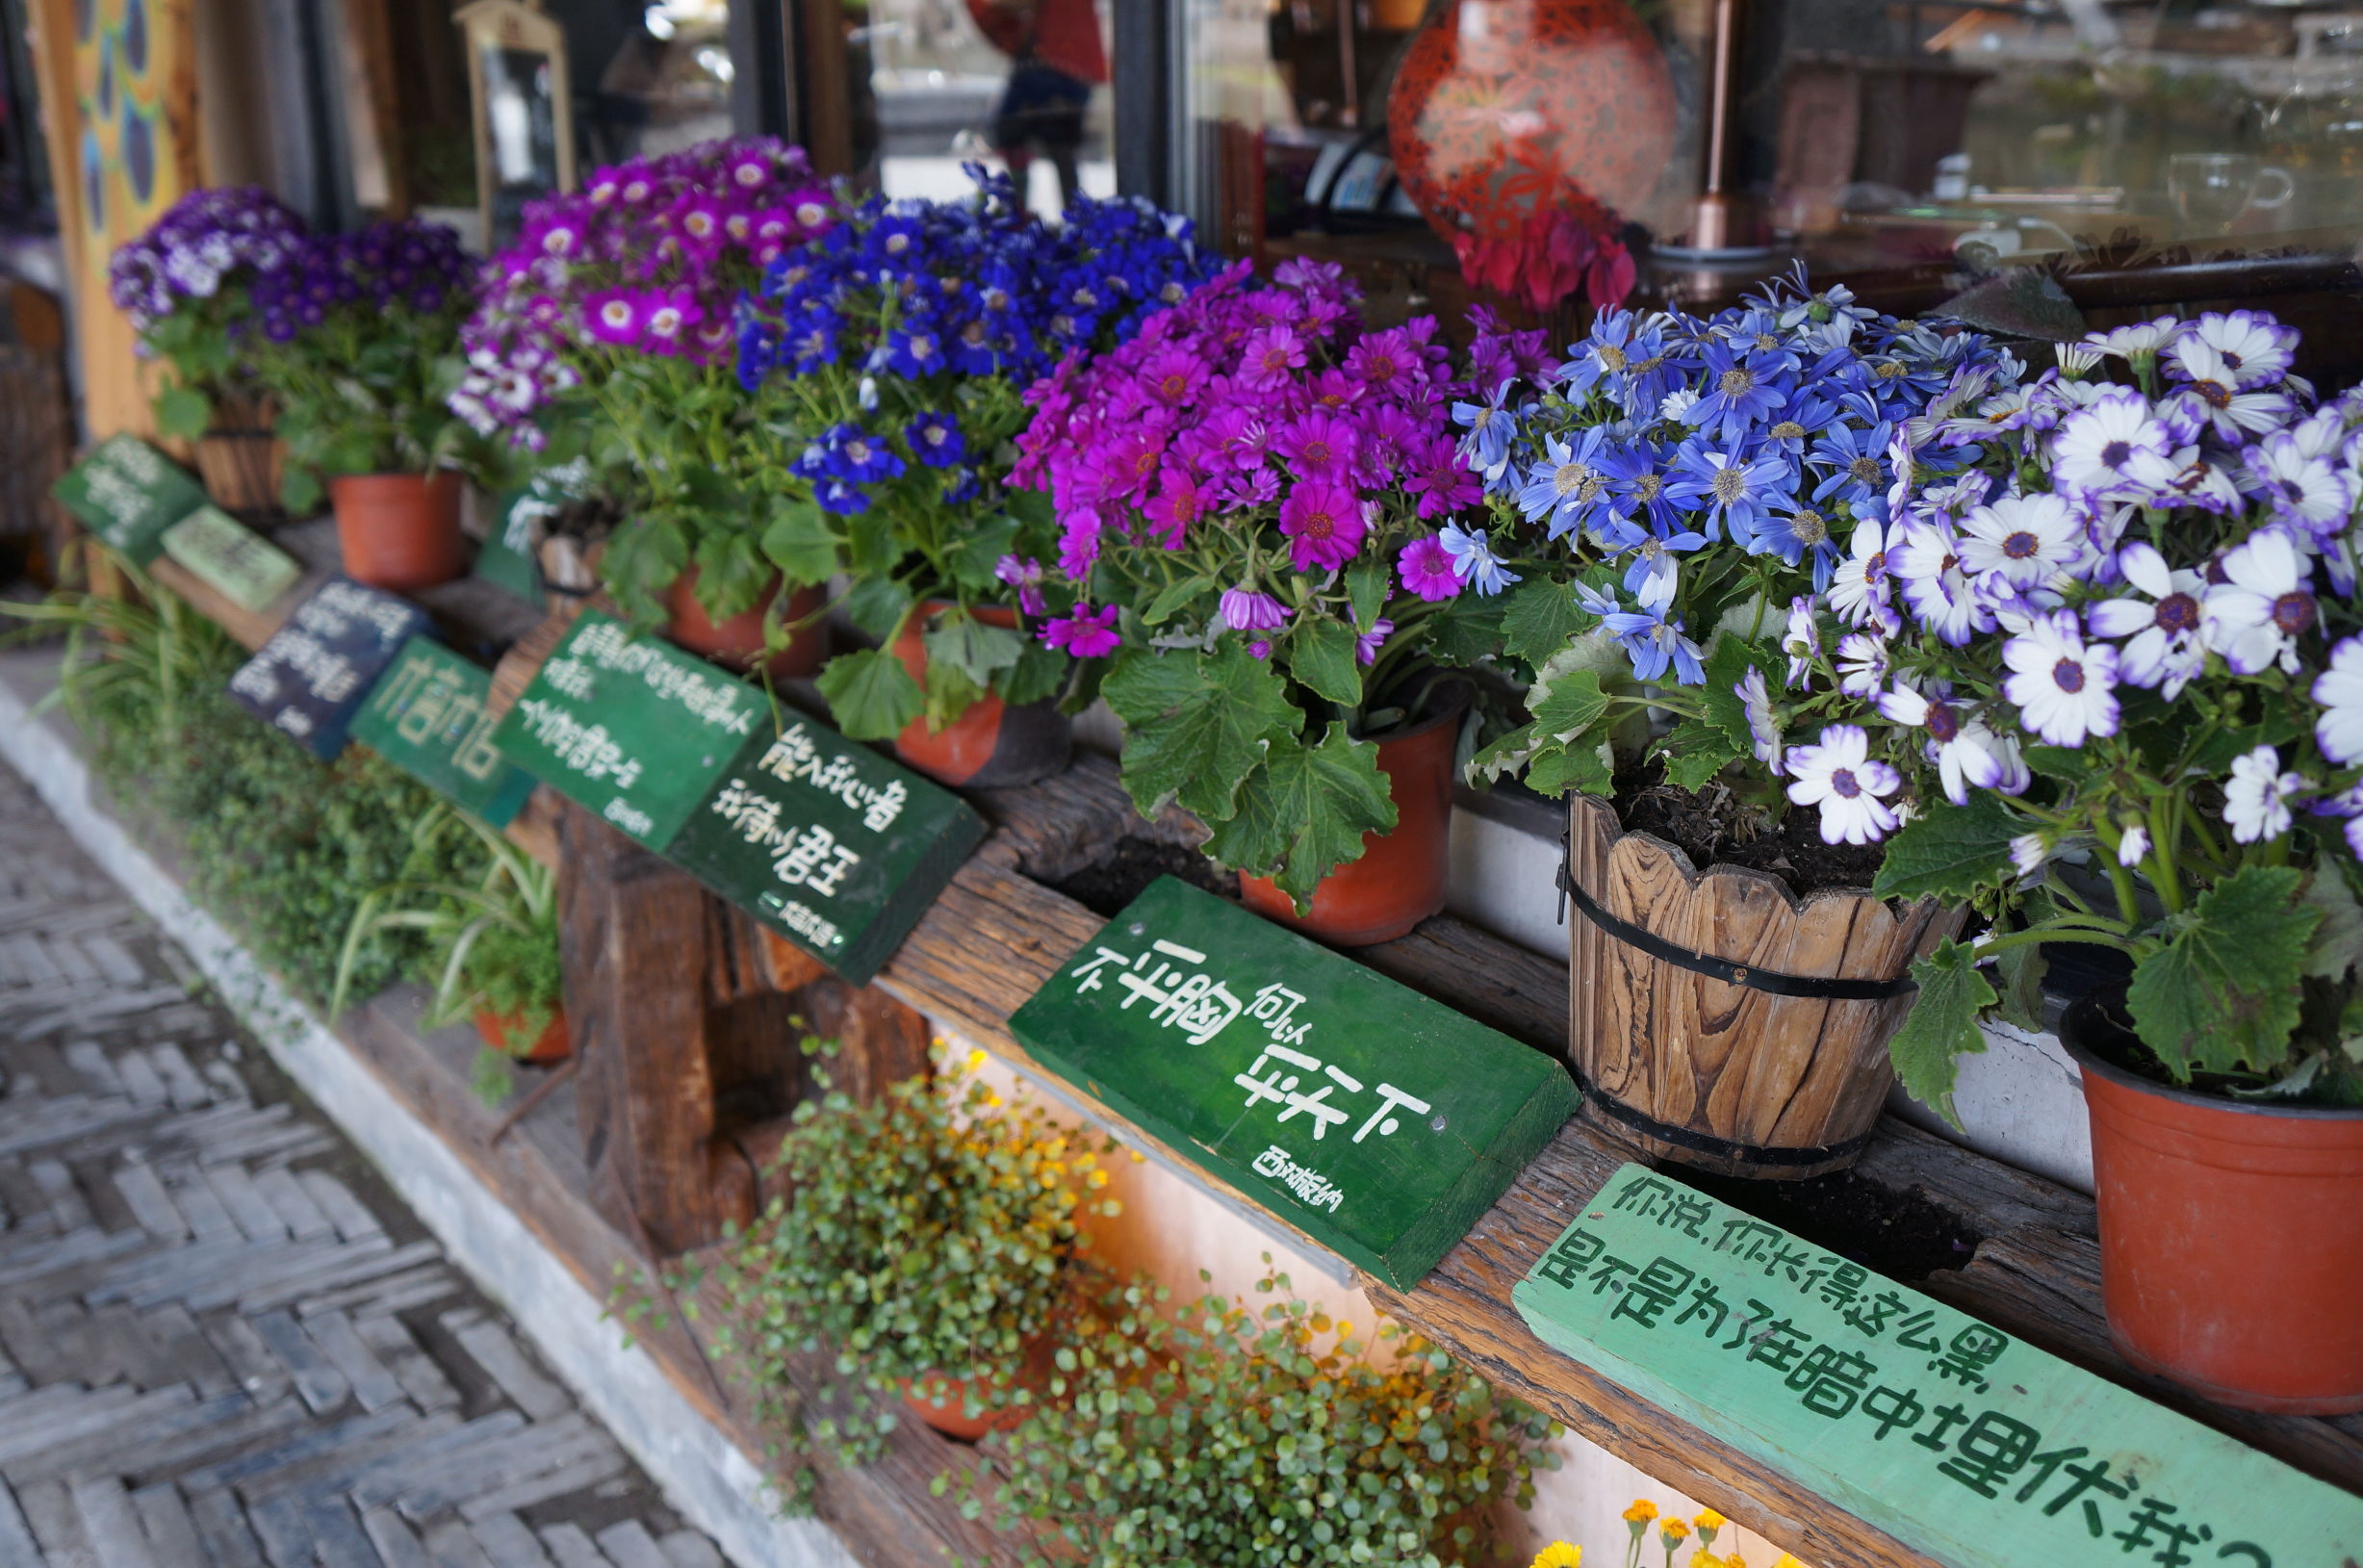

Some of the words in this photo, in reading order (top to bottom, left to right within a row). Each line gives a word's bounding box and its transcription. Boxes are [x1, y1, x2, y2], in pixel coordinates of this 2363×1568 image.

[758, 723, 908, 834] 能入我心者
[711, 779, 860, 897] 我待以君王
[1252, 1144, 1344, 1214] 西双版纳
